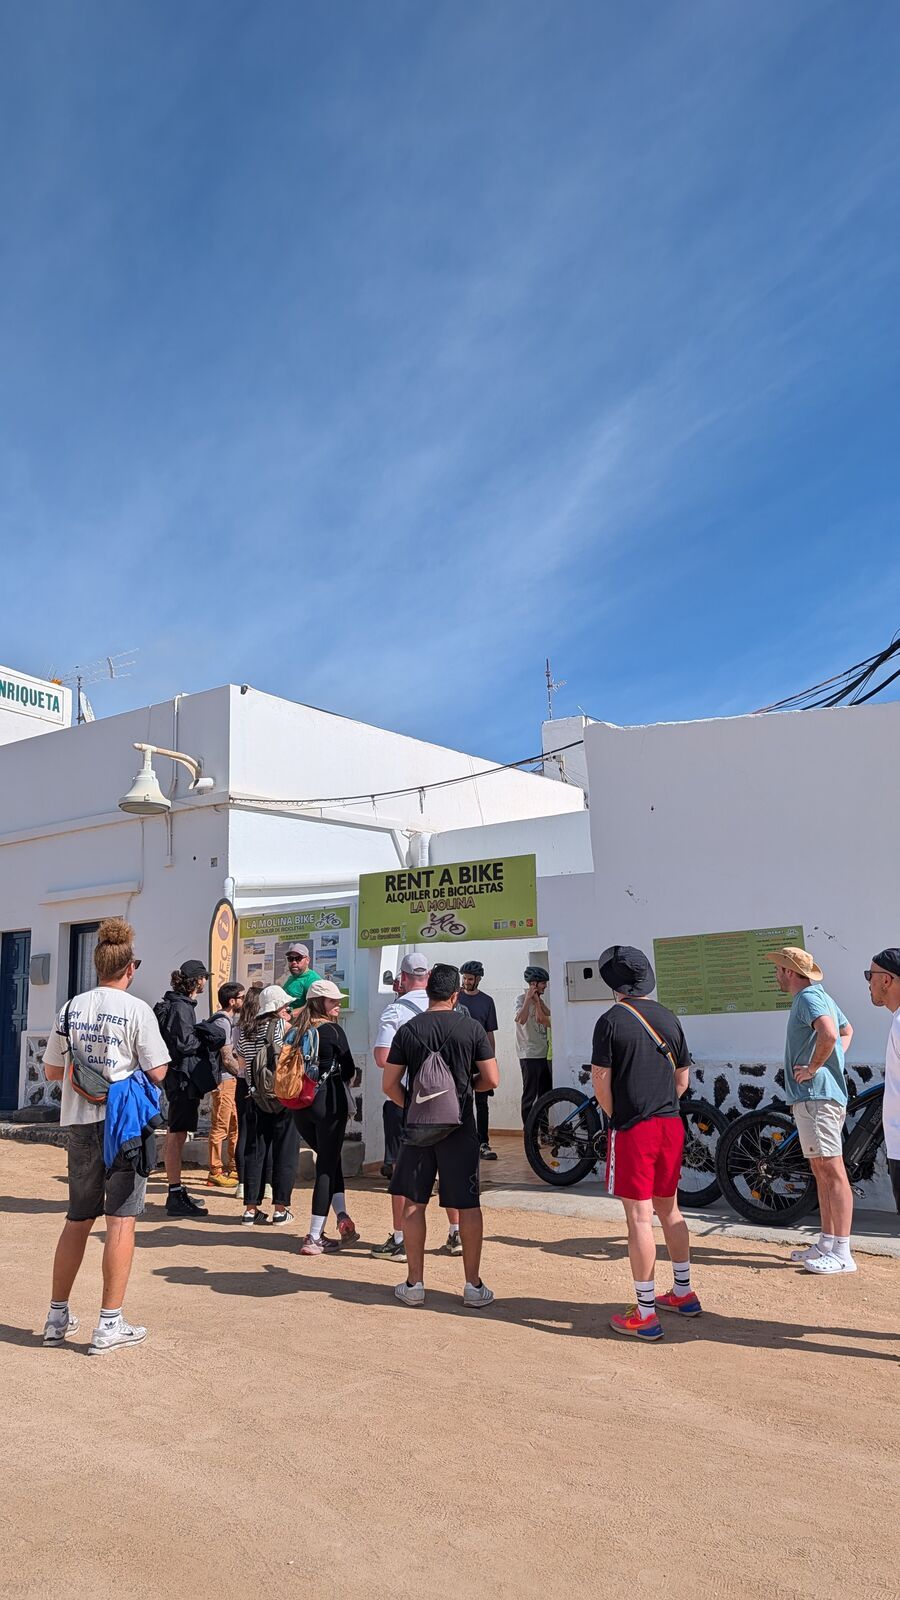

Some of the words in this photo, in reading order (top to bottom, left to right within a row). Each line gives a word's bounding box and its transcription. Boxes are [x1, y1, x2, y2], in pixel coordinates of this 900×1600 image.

[0, 679, 60, 713] NRIQUETA
[385, 870, 434, 892] RENT
[439, 868, 454, 886] A
[459, 862, 504, 884] BIKE
[385, 889, 430, 903] ALQUILER
[433, 888, 445, 898] DE
[448, 882, 504, 897] BICICLETAS
[410, 901, 425, 913] LA
[428, 896, 476, 912] MOLINA
[246, 920, 257, 929] LA
[259, 916, 293, 928] MOLINA
[295, 914, 315, 924] BIKE
[217, 945, 228, 989] NFO
[97, 1013, 129, 1027] STREET
[85, 1045, 93, 1053] IS
